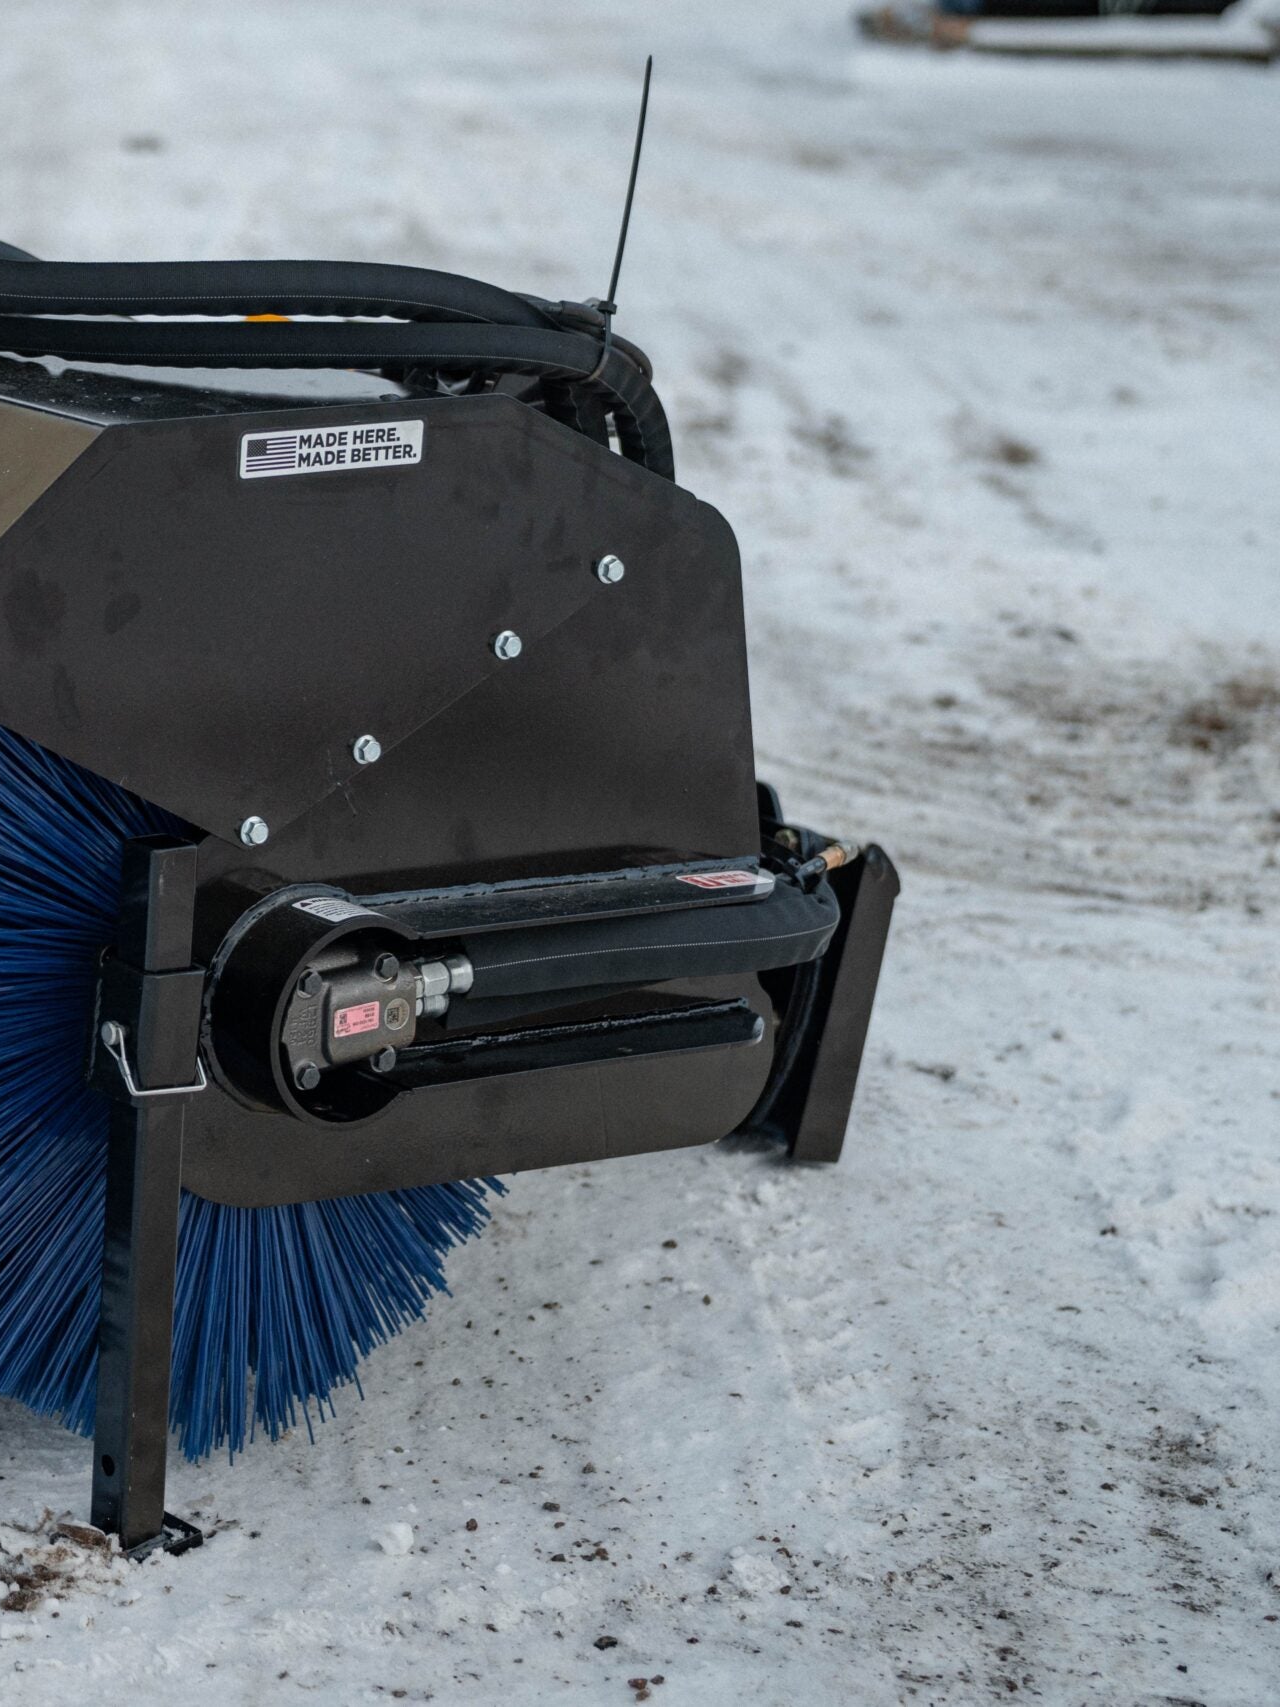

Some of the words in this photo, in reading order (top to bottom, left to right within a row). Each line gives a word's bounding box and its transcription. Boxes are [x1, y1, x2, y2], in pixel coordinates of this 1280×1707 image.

[298, 431, 348, 449] MADE
[352, 427, 400, 445] HERE.
[297, 449, 346, 468] MADE
[351, 444, 417, 463] BETTER.
